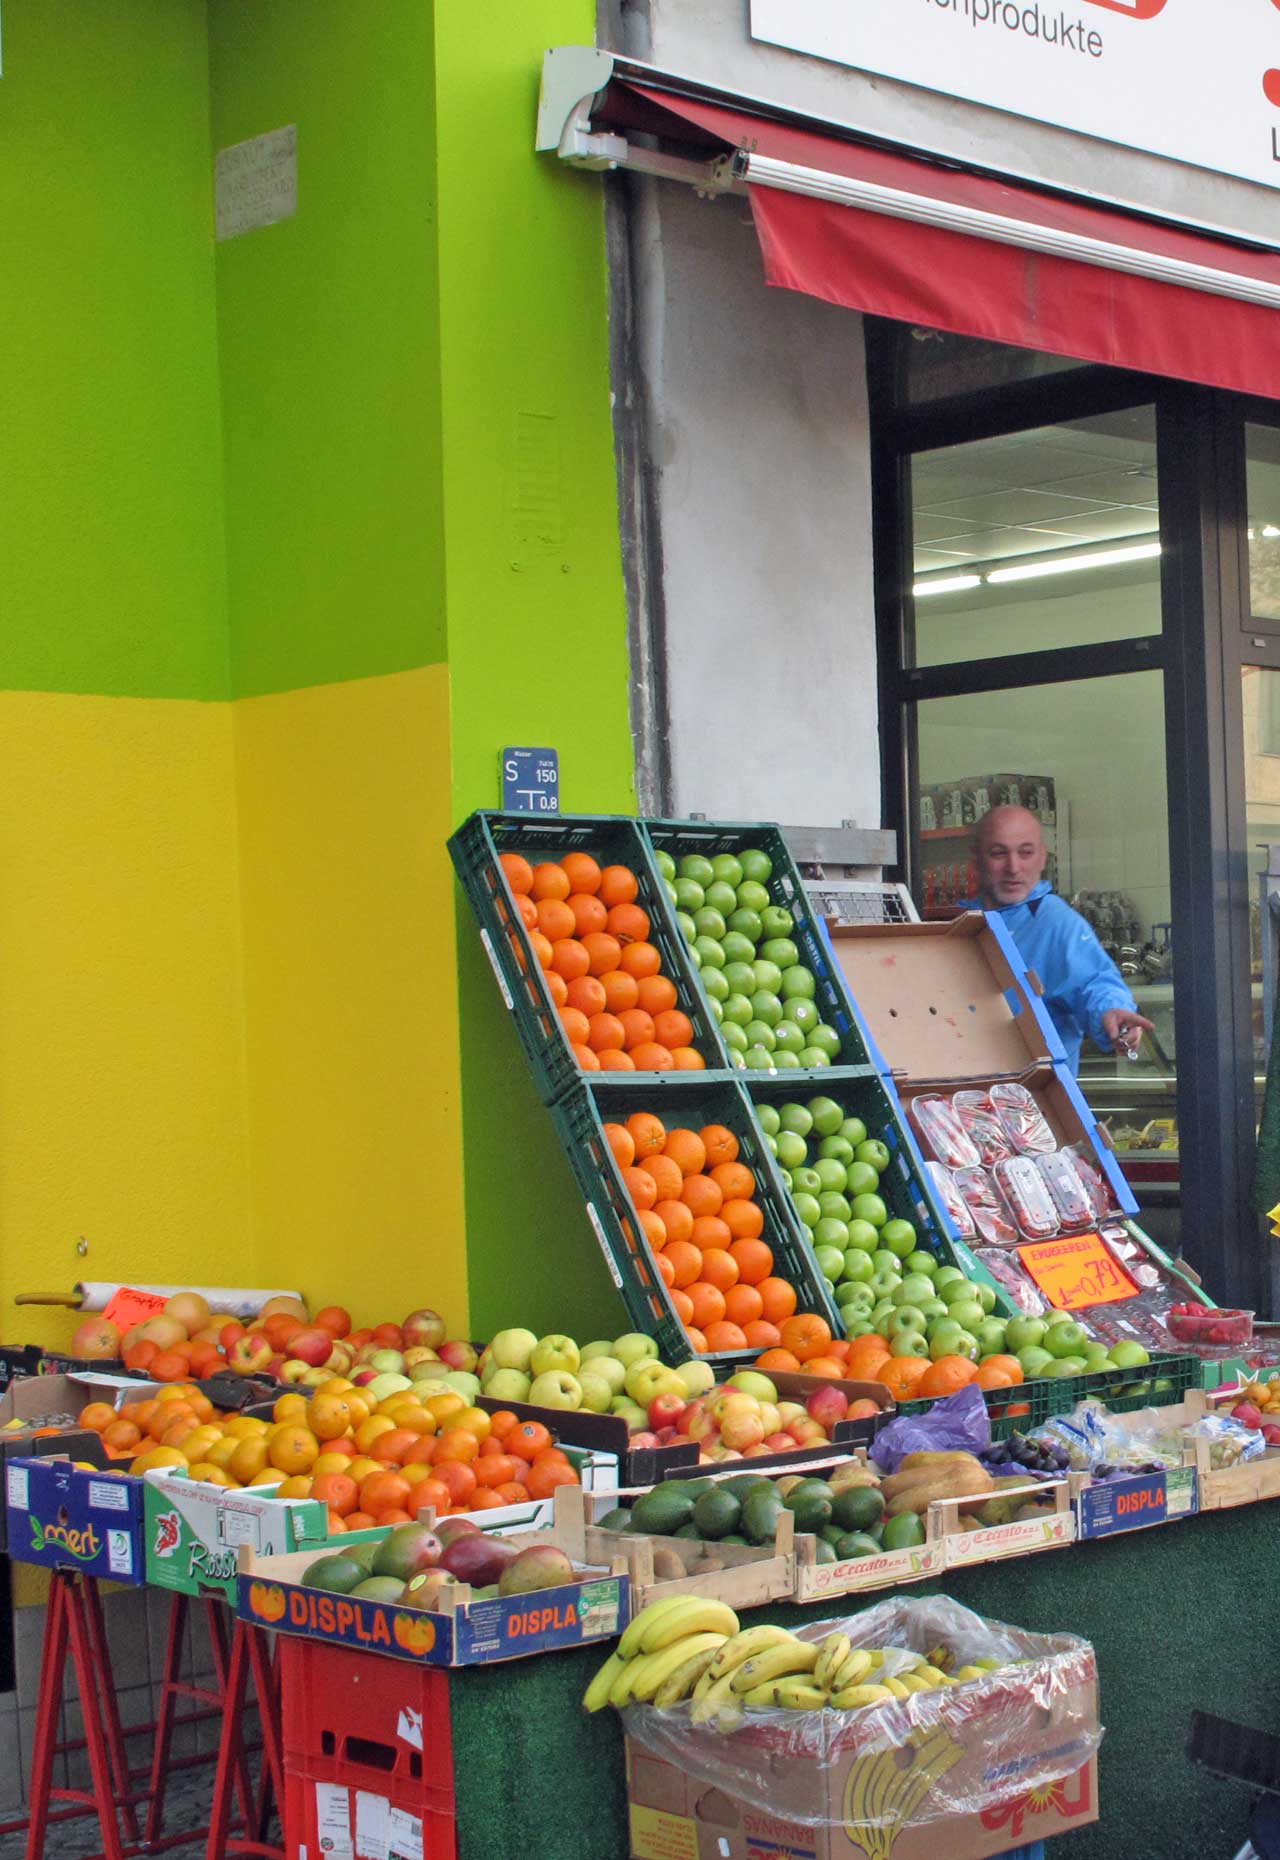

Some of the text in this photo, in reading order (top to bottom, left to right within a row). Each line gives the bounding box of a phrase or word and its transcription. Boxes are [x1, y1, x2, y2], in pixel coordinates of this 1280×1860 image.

[505, 760, 557, 783] S 150
[539, 796, 558, 810] 0,8
[1116, 1487, 1164, 1515] DISPLA
[44, 1522, 100, 1555] mert
[290, 1591, 392, 1647] DISPLA
[508, 1604, 577, 1638] DISPLA
